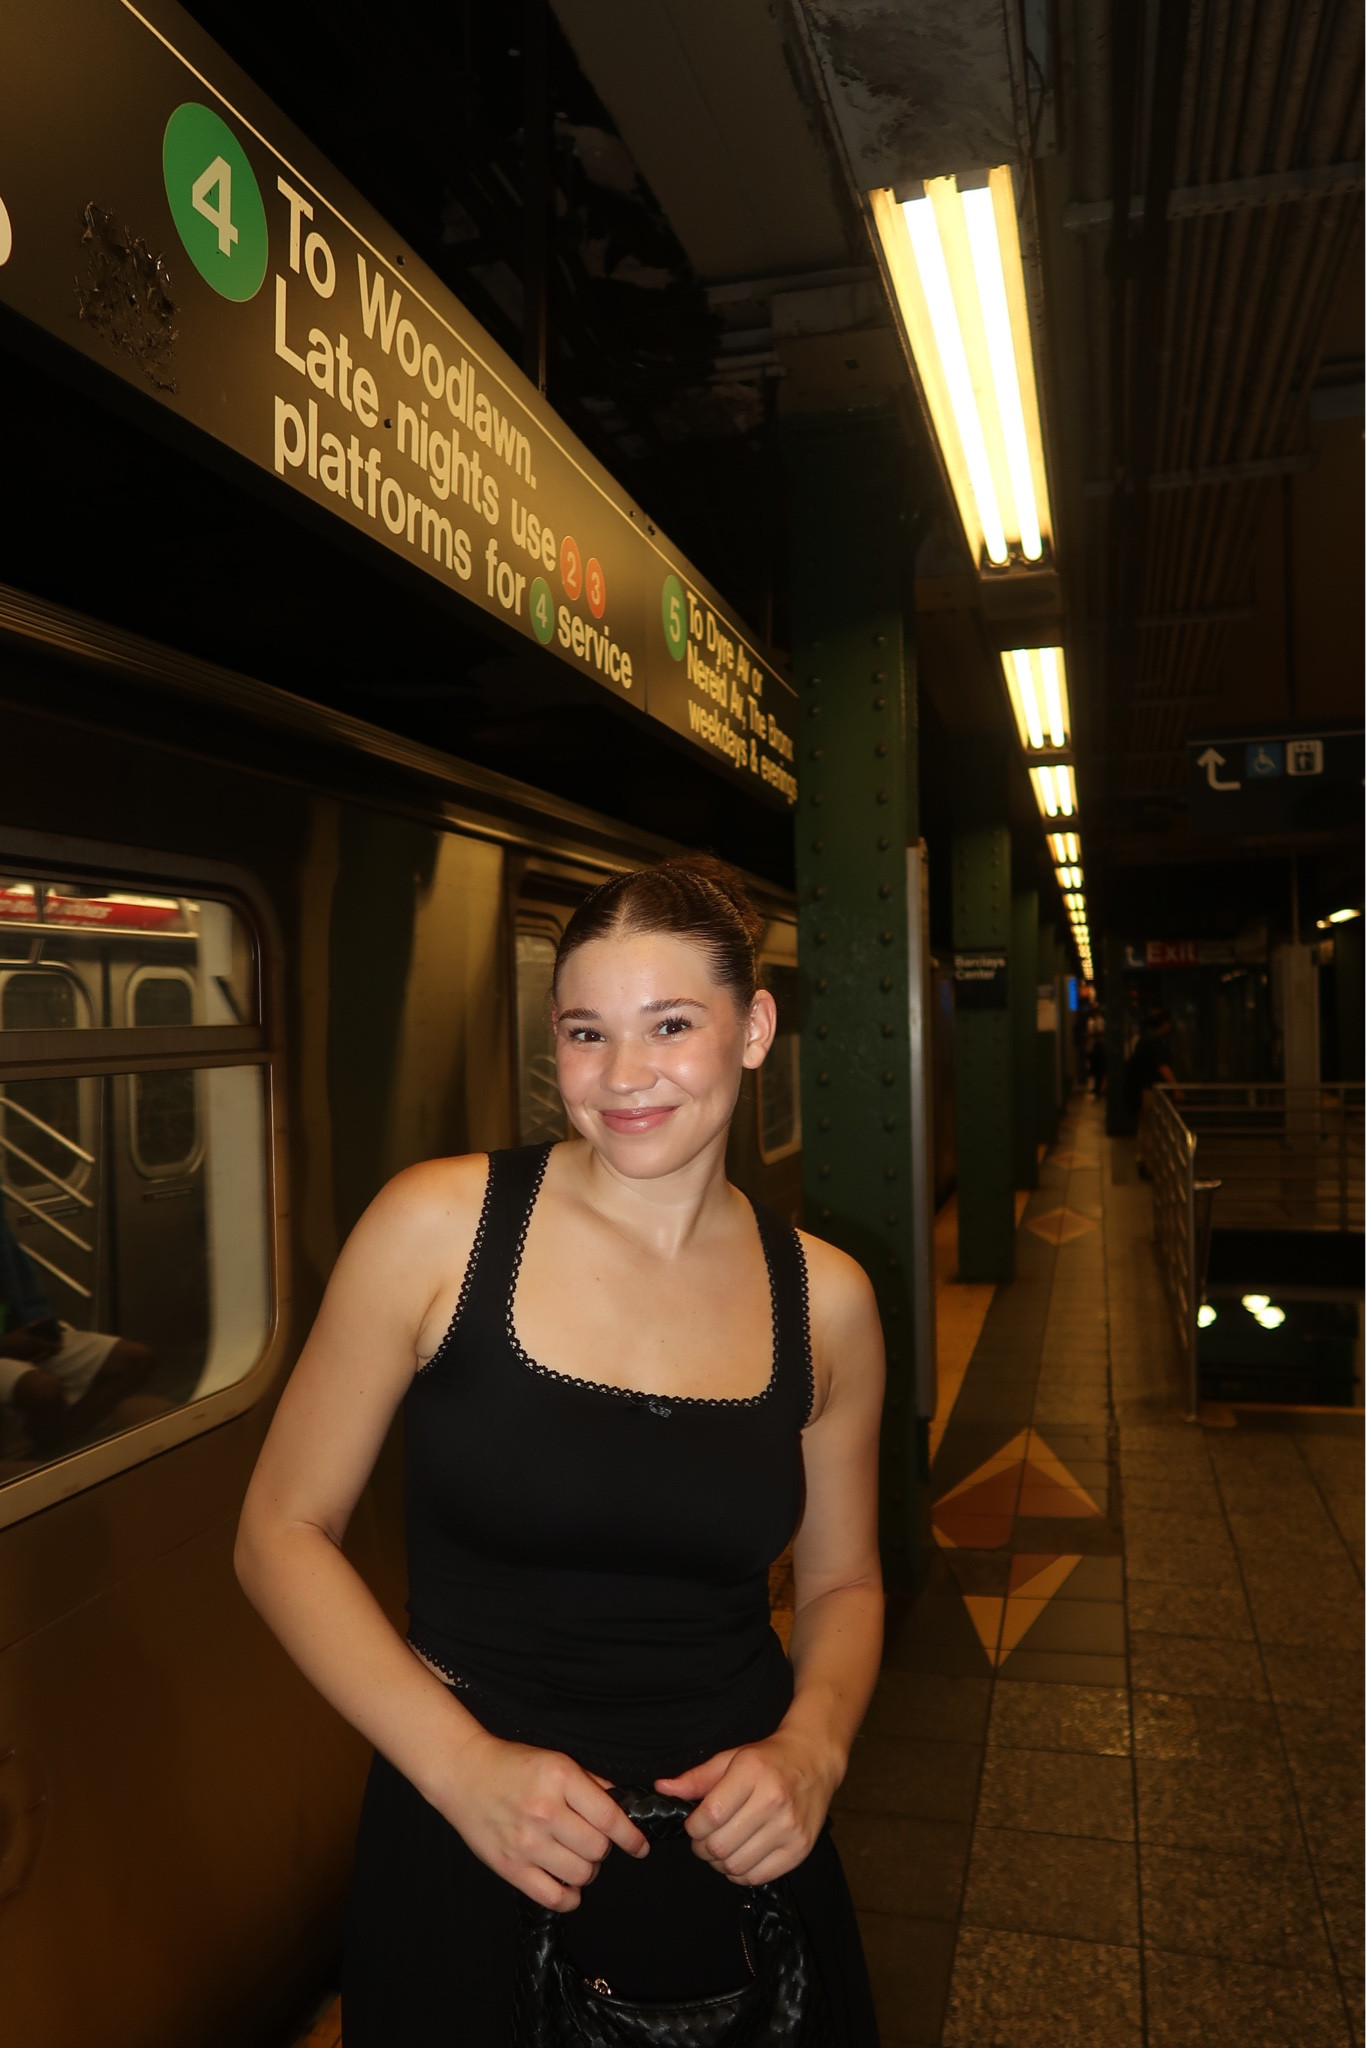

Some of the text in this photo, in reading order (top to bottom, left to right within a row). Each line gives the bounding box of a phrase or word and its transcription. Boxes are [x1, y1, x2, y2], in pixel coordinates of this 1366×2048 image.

[192, 156, 536, 489] 4 To Woodlawn.
[275, 273, 601, 606] Late nights use 2 3
[274, 395, 632, 689] platforms for 4 service
[669, 591, 763, 697] 5 To Dyre Av or
[686, 640, 727, 708] Nereid
[747, 695, 766, 740] The
[688, 699, 748, 768] weekdays
[750, 738, 758, 775] &
[954, 955, 1006, 970] Barclays
[955, 968, 996, 981] Center
[1147, 941, 1196, 962] Exit
